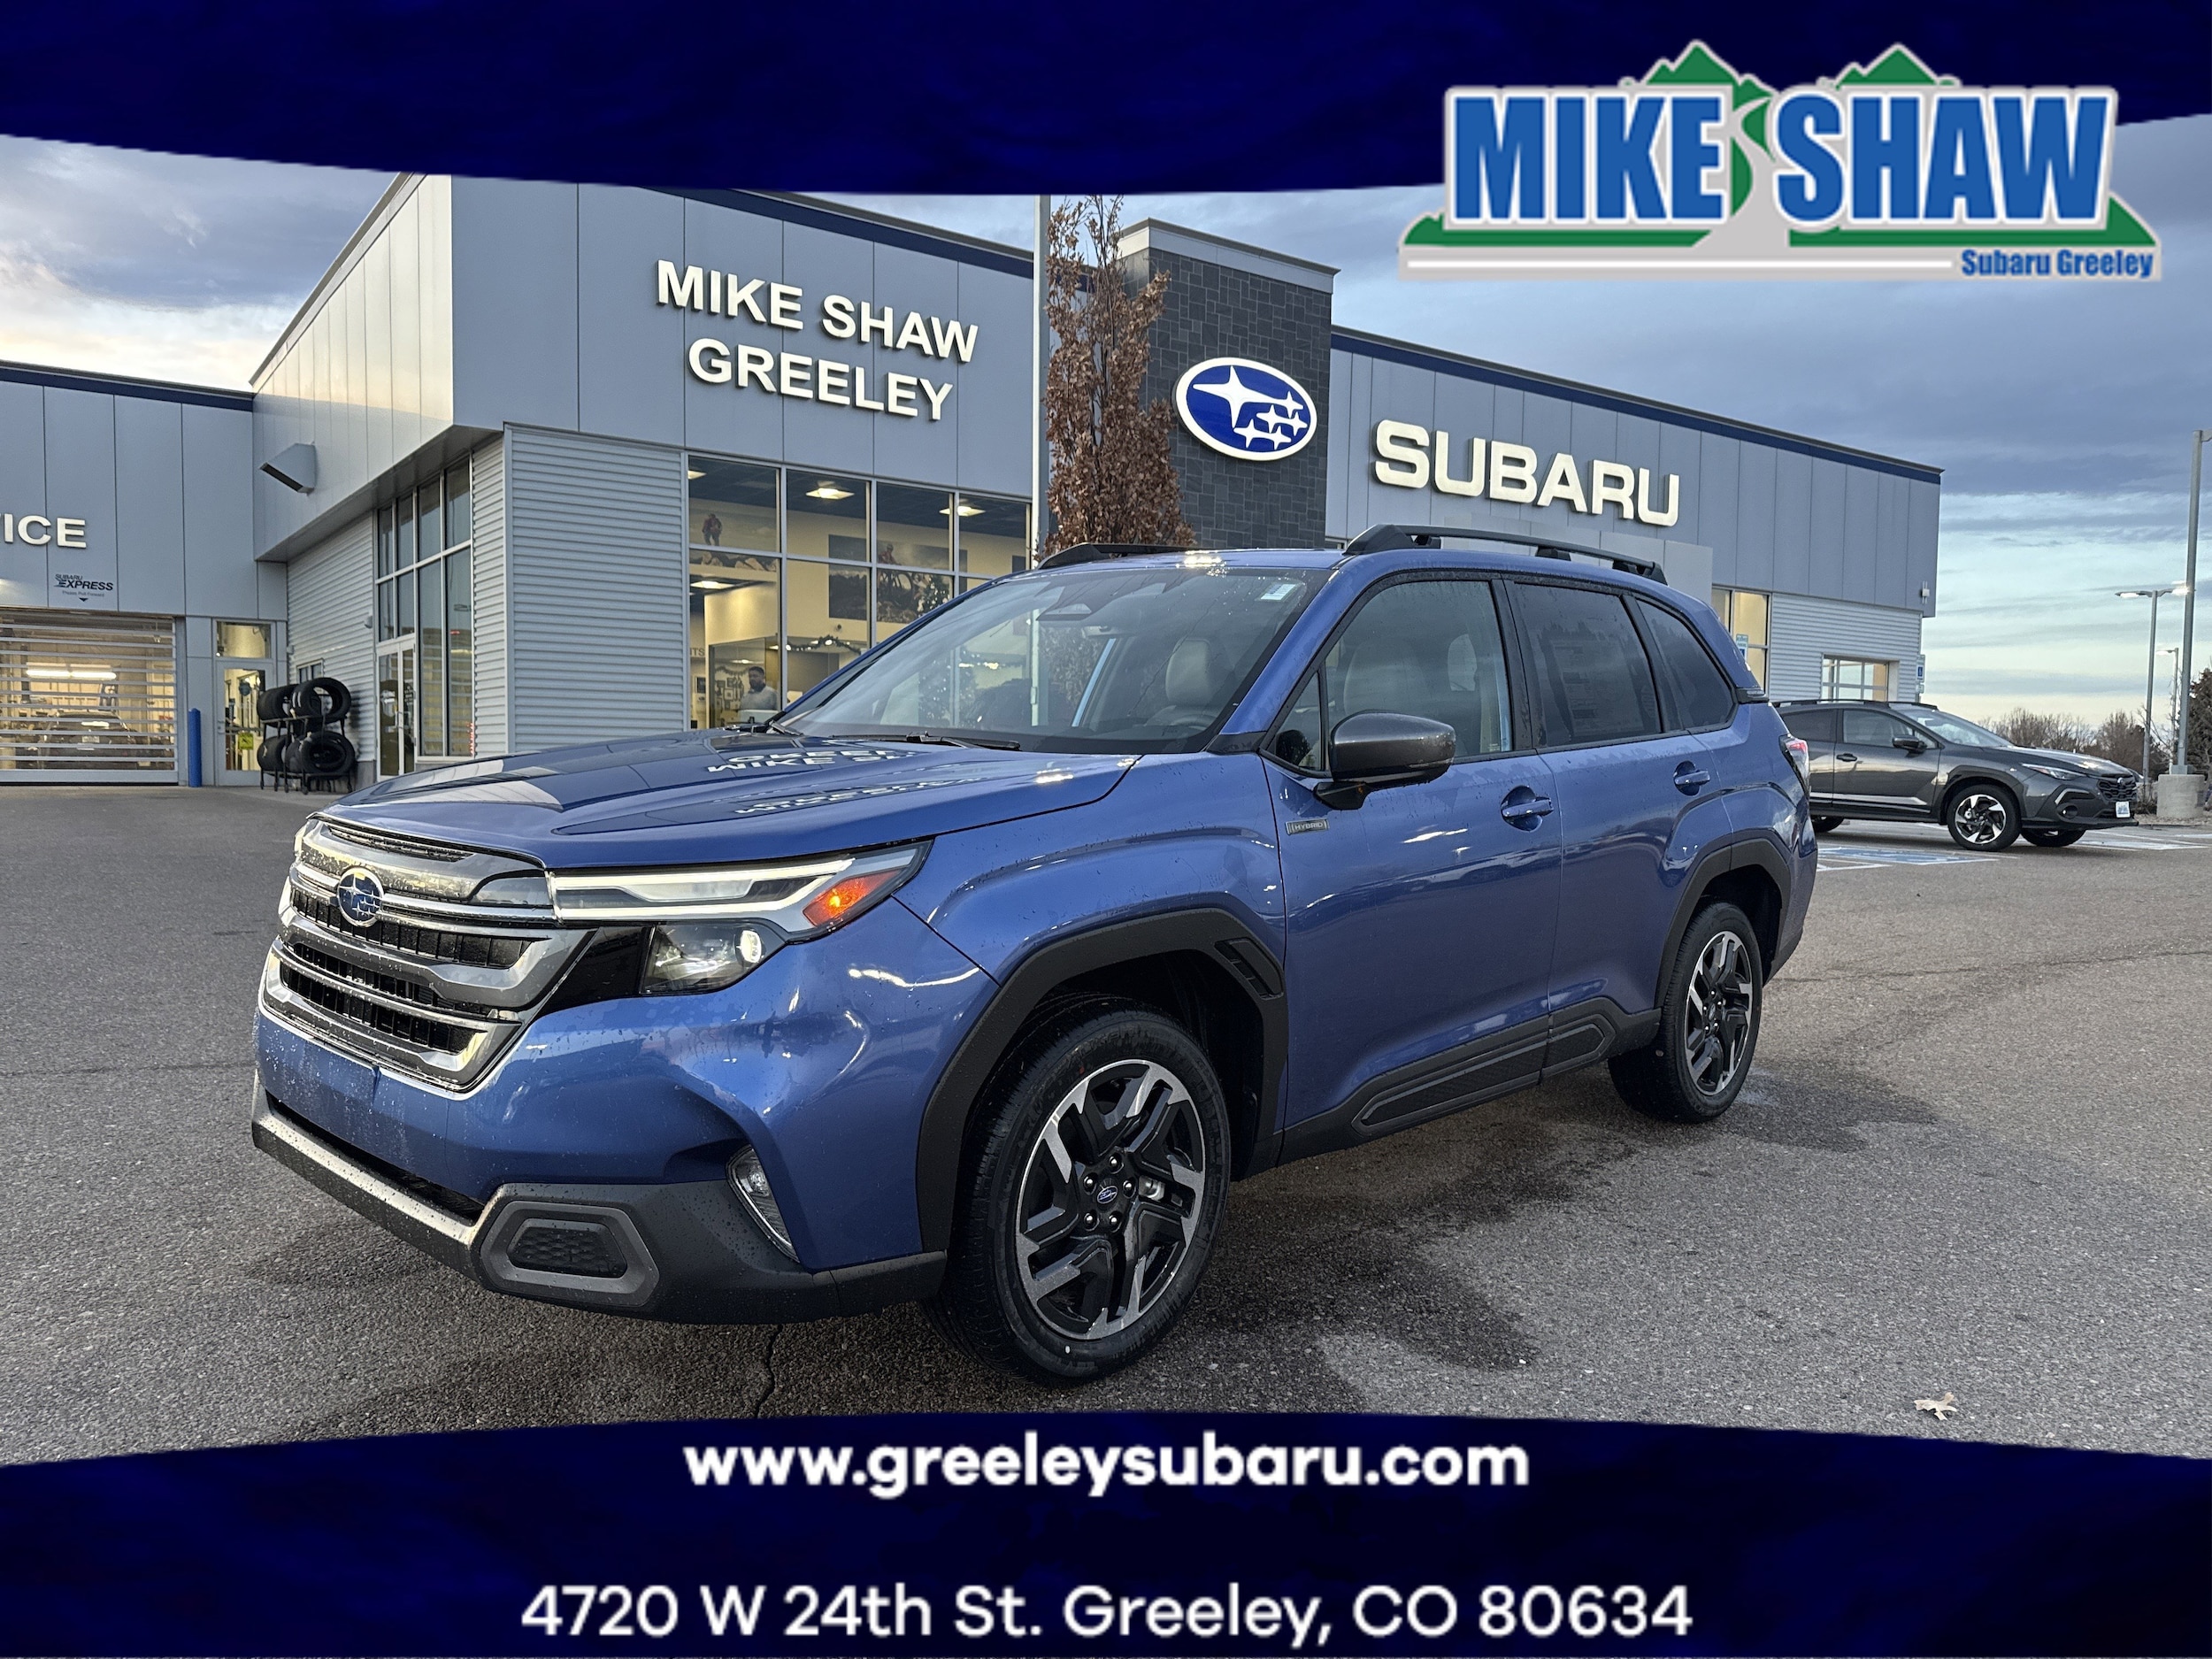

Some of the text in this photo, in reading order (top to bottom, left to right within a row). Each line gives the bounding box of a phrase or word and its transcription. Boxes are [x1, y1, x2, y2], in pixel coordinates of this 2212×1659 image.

[657, 259, 979, 363] MIKE SHAW
[688, 337, 954, 420] GREELEY
[1374, 419, 1680, 527] SUBARU
[0, 513, 87, 548] ICE
[58, 580, 113, 591] EXPRESS
